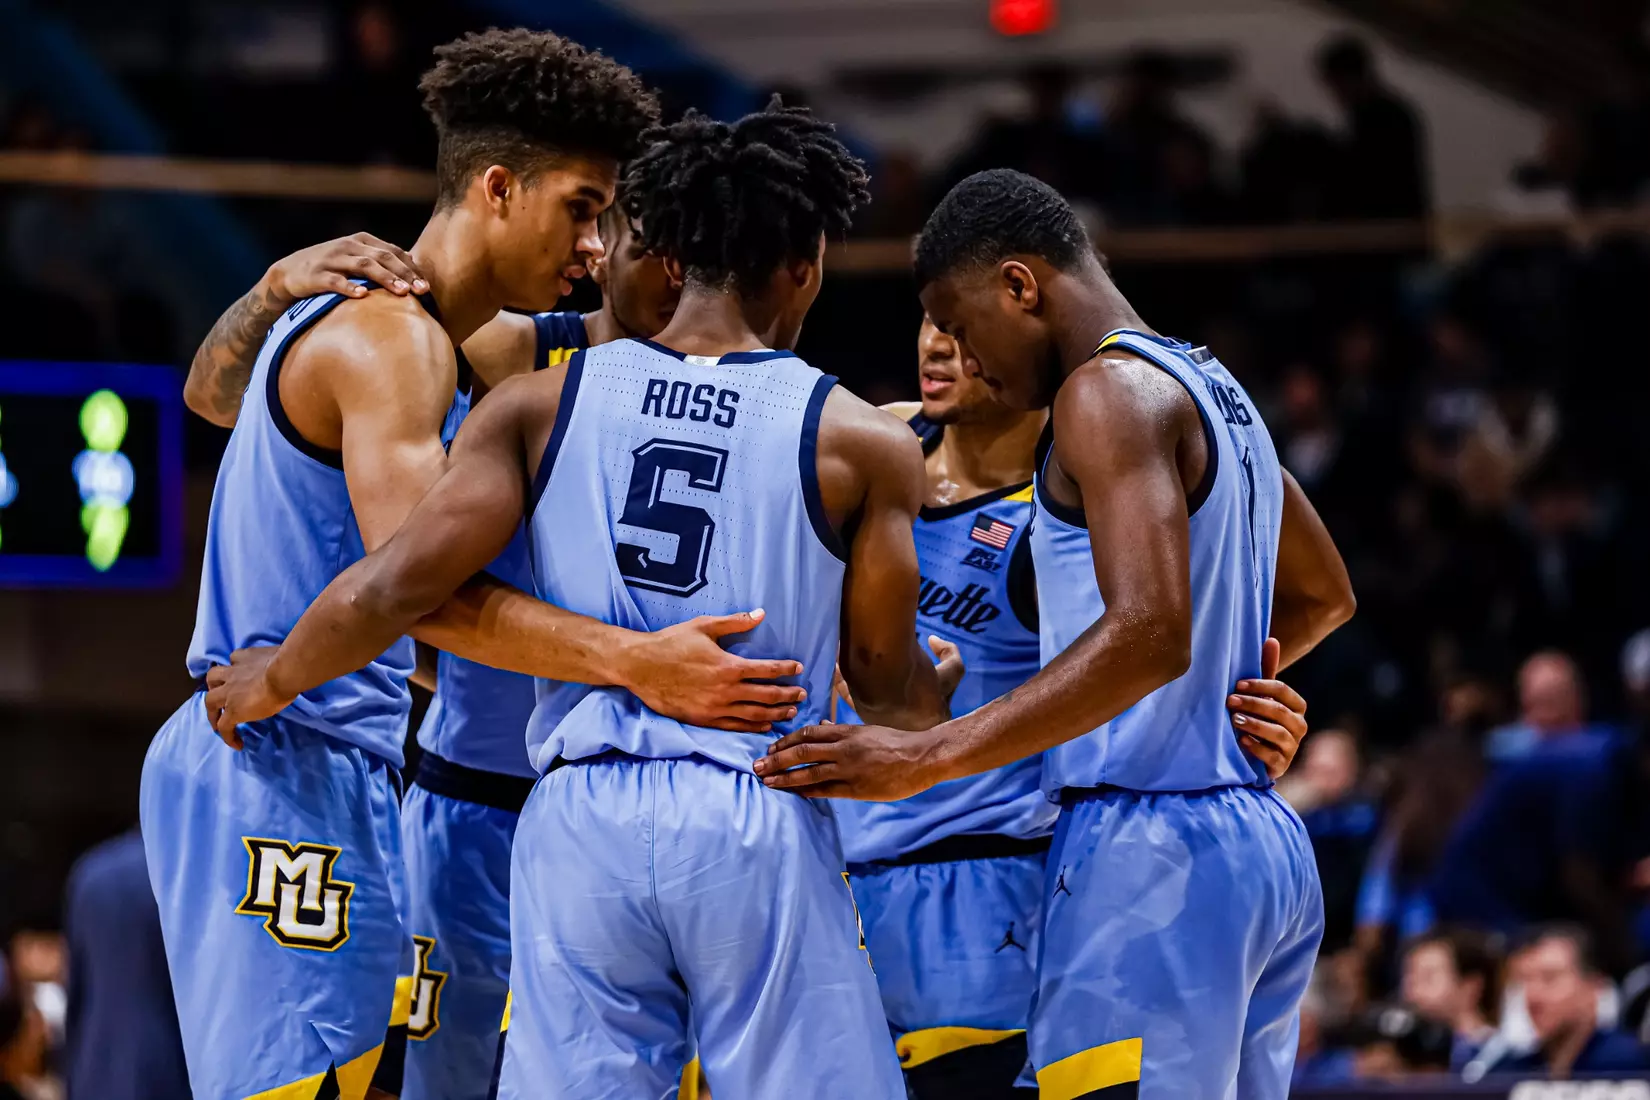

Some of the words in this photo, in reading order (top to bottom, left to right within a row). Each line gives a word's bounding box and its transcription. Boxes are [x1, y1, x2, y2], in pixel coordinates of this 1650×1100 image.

[641, 378, 740, 429] ROSS
[616, 437, 730, 598] 5
[236, 837, 354, 951] MU
